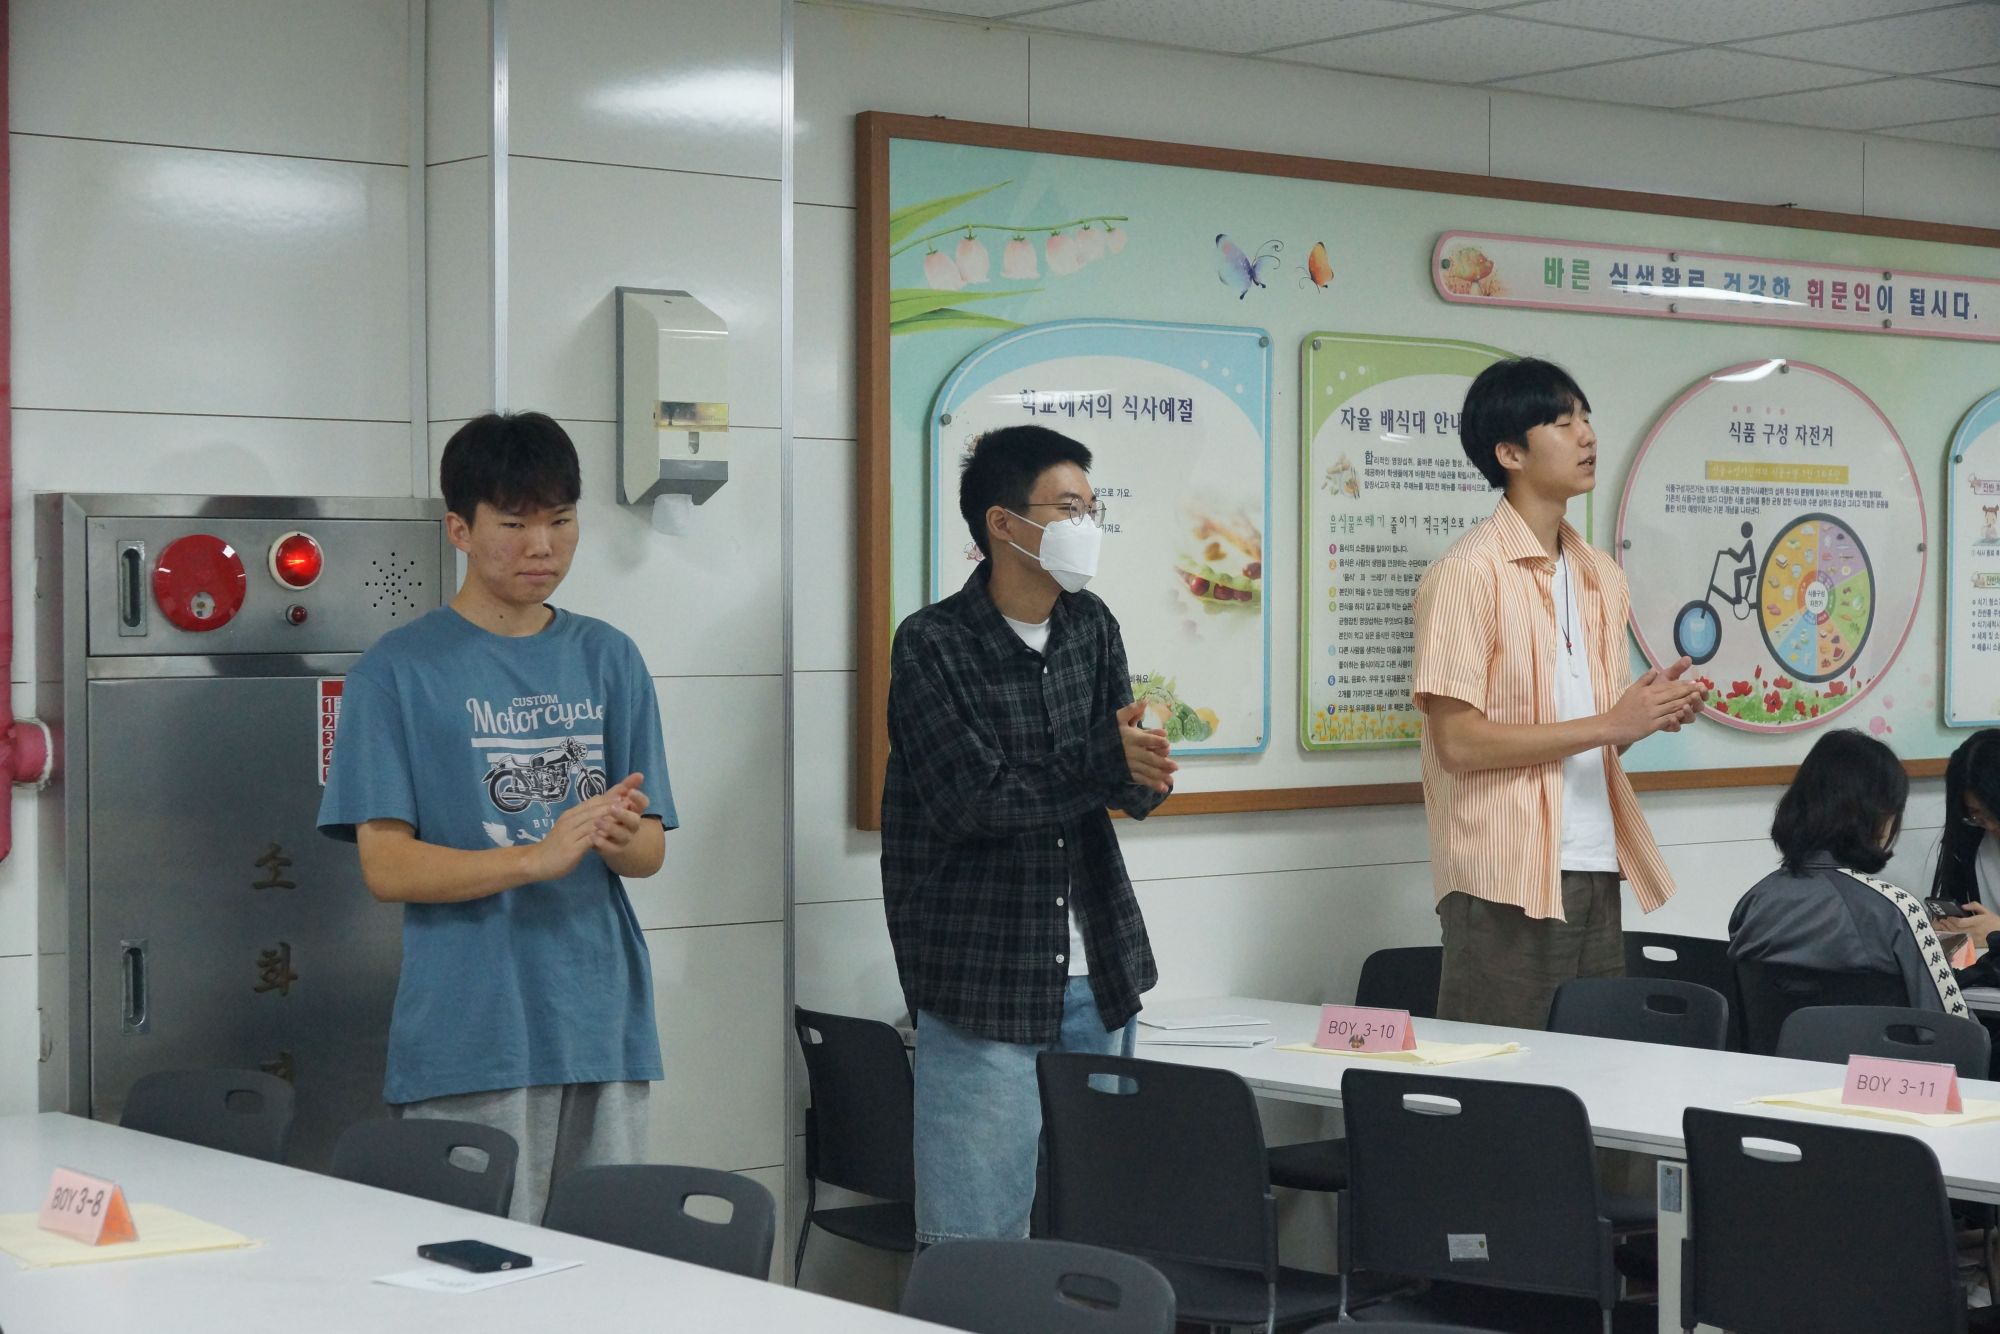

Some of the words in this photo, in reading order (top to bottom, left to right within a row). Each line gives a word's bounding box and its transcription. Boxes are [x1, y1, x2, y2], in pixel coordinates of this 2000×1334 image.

[1544, 257, 1590, 290] 바른
[1806, 279, 1894, 314] 휘문인이
[1909, 288, 1978, 320] 됩시다.
[1122, 396, 1194, 422] 식사예절
[1341, 407, 1372, 431] 자율
[1380, 410, 1426, 434] 배식대
[1728, 421, 1755, 444] 식품
[1762, 423, 1789, 445] 구성
[1795, 425, 1833, 447] 자전거
[1330, 514, 1384, 534] 음식물쓰레기
[1391, 515, 1416, 534] 줄이기
[1424, 515, 1464, 535] 적극적으로
[325, 698, 332, 712] 1
[512, 694, 558, 707] CUSTOM
[325, 715, 333, 728] 2
[325, 732, 334, 746] 3
[1328, 1021, 1357, 1035] BOY
[1363, 1023, 1394, 1038] 3-10
[1857, 1074, 1891, 1092] BOY
[1899, 1078, 1935, 1097] 3-11
[51, 1186, 78, 1212] BOY
[76, 1187, 104, 1217] 3-8
